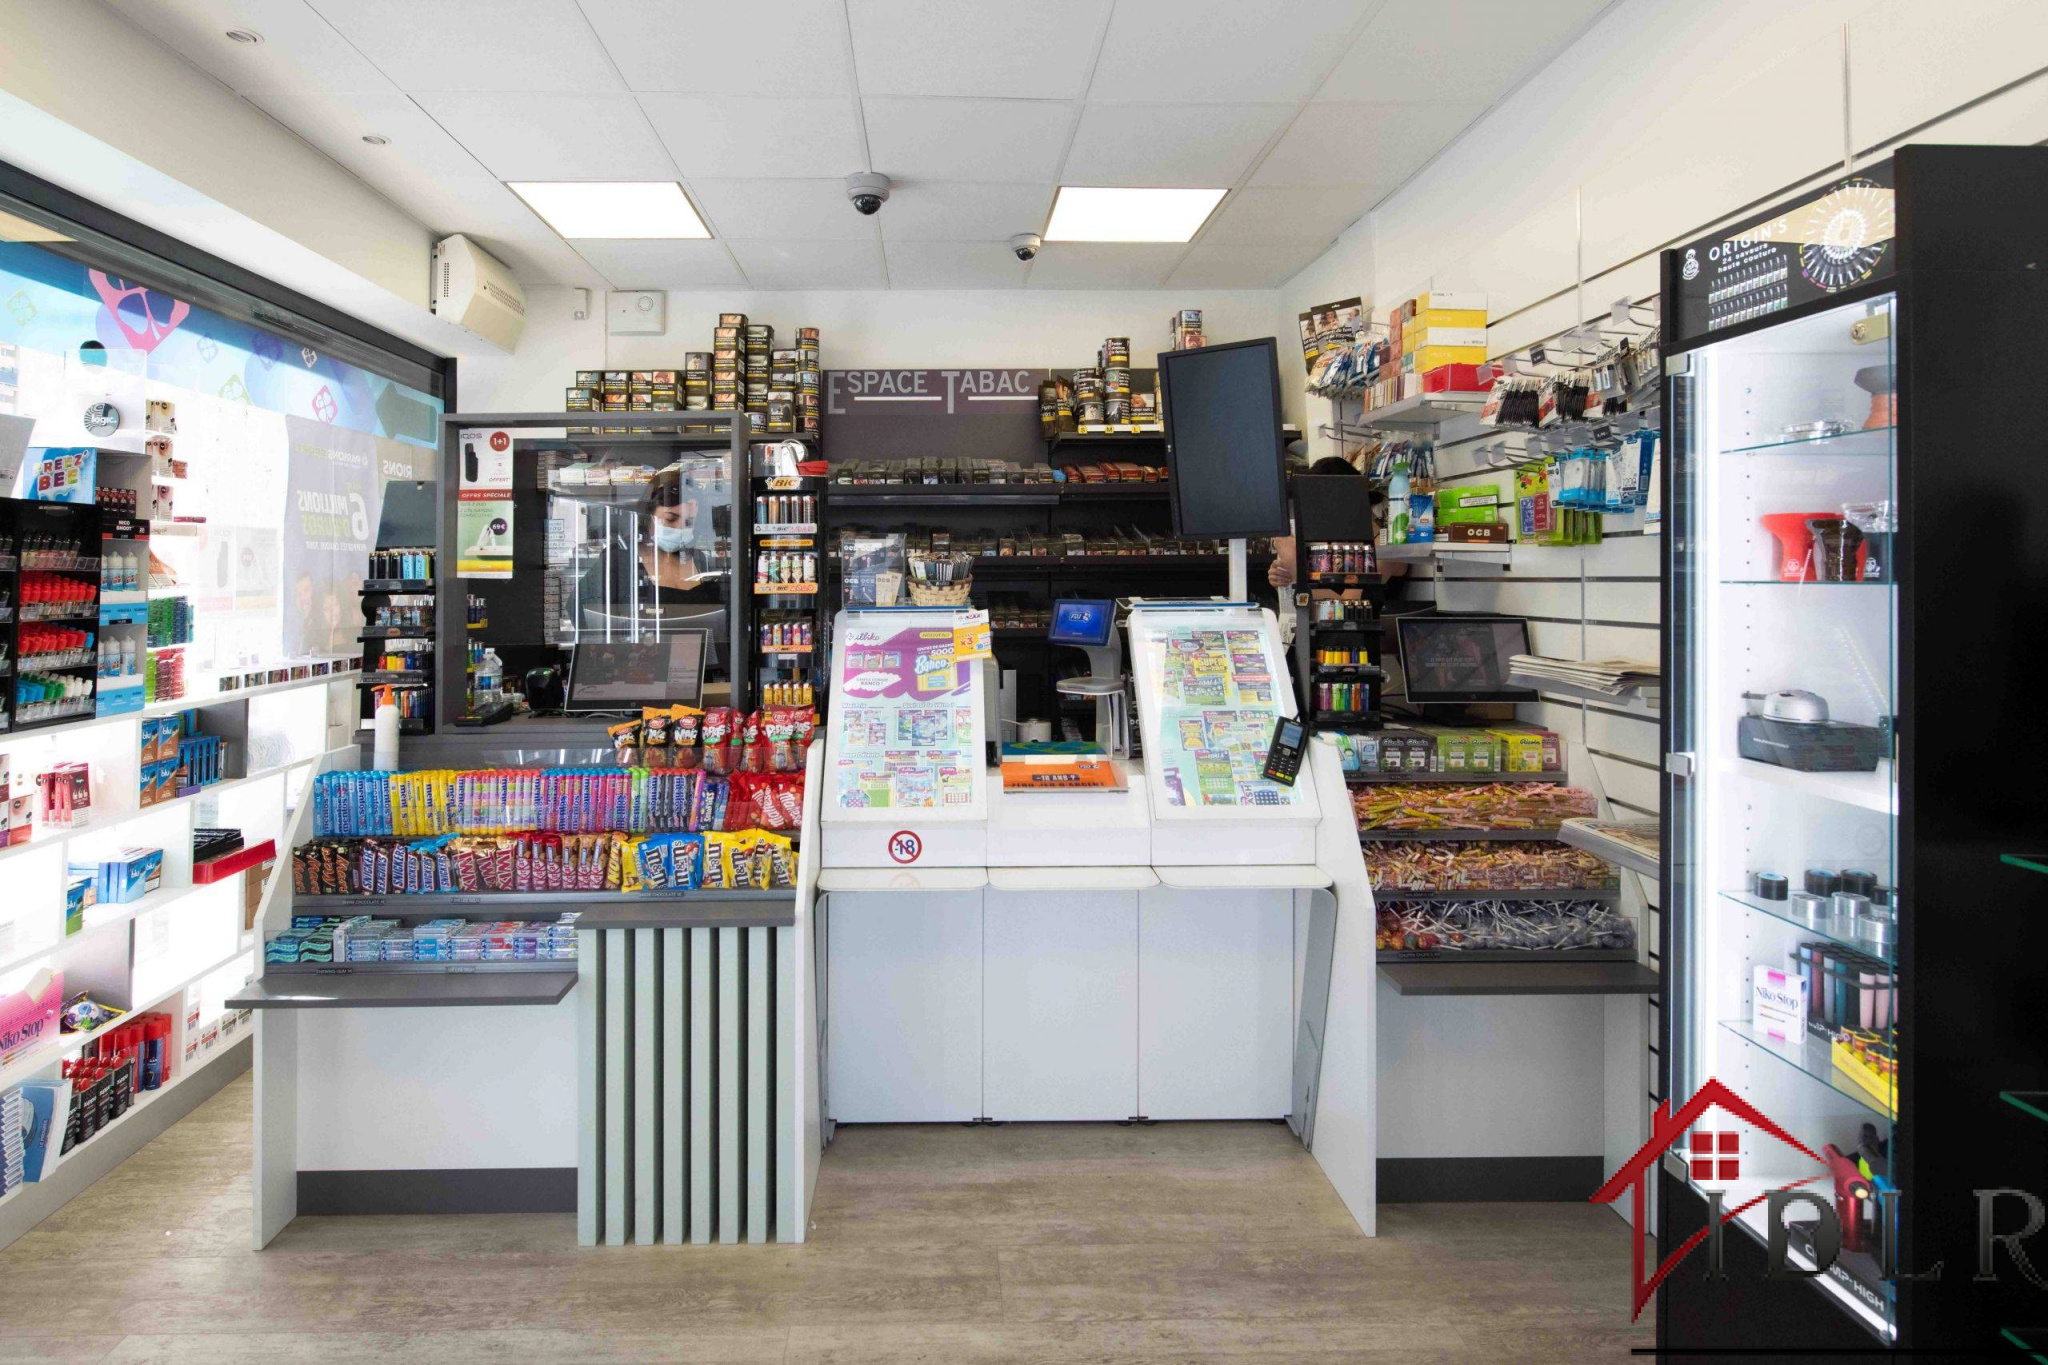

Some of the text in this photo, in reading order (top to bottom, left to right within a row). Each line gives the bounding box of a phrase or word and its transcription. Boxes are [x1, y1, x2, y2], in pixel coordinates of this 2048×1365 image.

[1709, 219, 1787, 261] ORIGIN'S
[1718, 247, 1777, 273] haute couture
[1722, 243, 1768, 265] 24 saveurs
[828, 370, 1030, 415] ESPACE TABAC
[494, 437, 507, 446] 1+1
[38, 468, 78, 491] BEE
[775, 479, 796, 487] BIC
[1467, 528, 1491, 537] OCB
[966, 637, 974, 645] 3
[914, 655, 946, 674] Banco
[162, 725, 173, 736] blu
[1520, 738, 1541, 746] Ricola
[160, 766, 170, 777] blu
[362, 849, 375, 891] SNICKER
[393, 844, 405, 888] SNICKERS
[407, 853, 418, 891] SNICKERS
[423, 855, 434, 892] SNICKERS
[437, 852, 450, 890] SNICKERS
[497, 849, 515, 891] TWIX
[1756, 985, 1799, 1011] Niko Stop
[21, 1017, 44, 1044] Stop
[1805, 1243, 1884, 1311] CMP-HIGH
